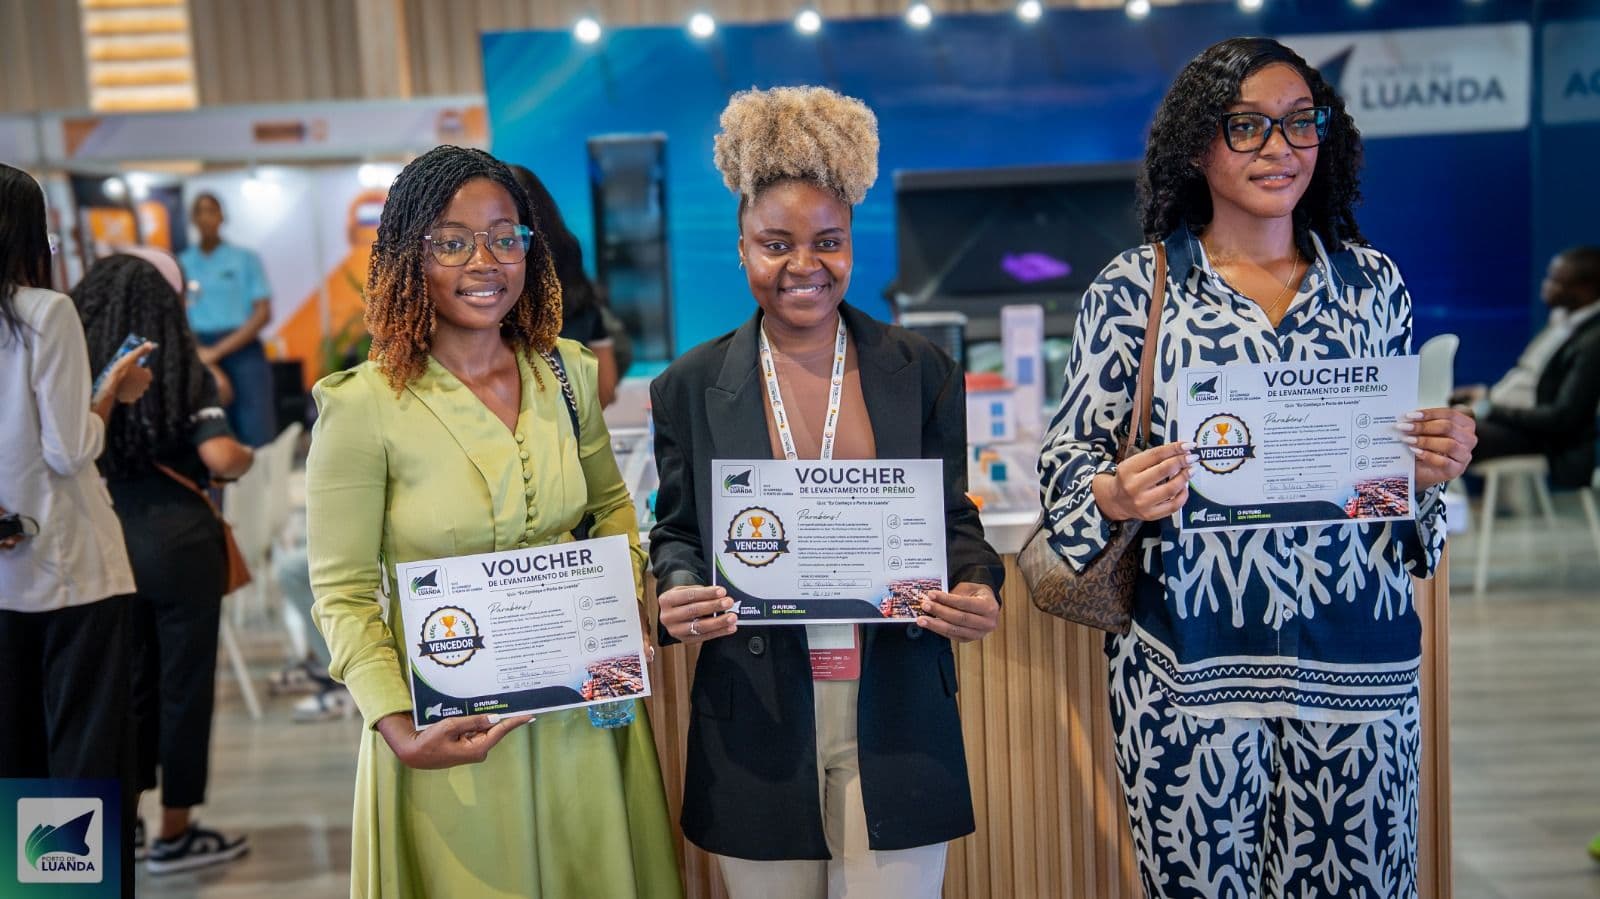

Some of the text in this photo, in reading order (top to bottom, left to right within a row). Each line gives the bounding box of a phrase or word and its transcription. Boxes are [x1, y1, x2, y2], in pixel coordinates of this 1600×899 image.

[1360, 76, 1505, 110] LUANDA
[1264, 366, 1380, 388] VOUCHER
[1279, 387, 1340, 396] LEVANTAMENTO
[1200, 448, 1244, 458] VENCEDOR
[795, 468, 906, 484] VOUCHER
[735, 541, 779, 550] VENCEDOR
[482, 549, 593, 578] VOUCHER
[500, 572, 557, 586] LEVANTAMENTO
[429, 639, 474, 652] VENCEDOR
